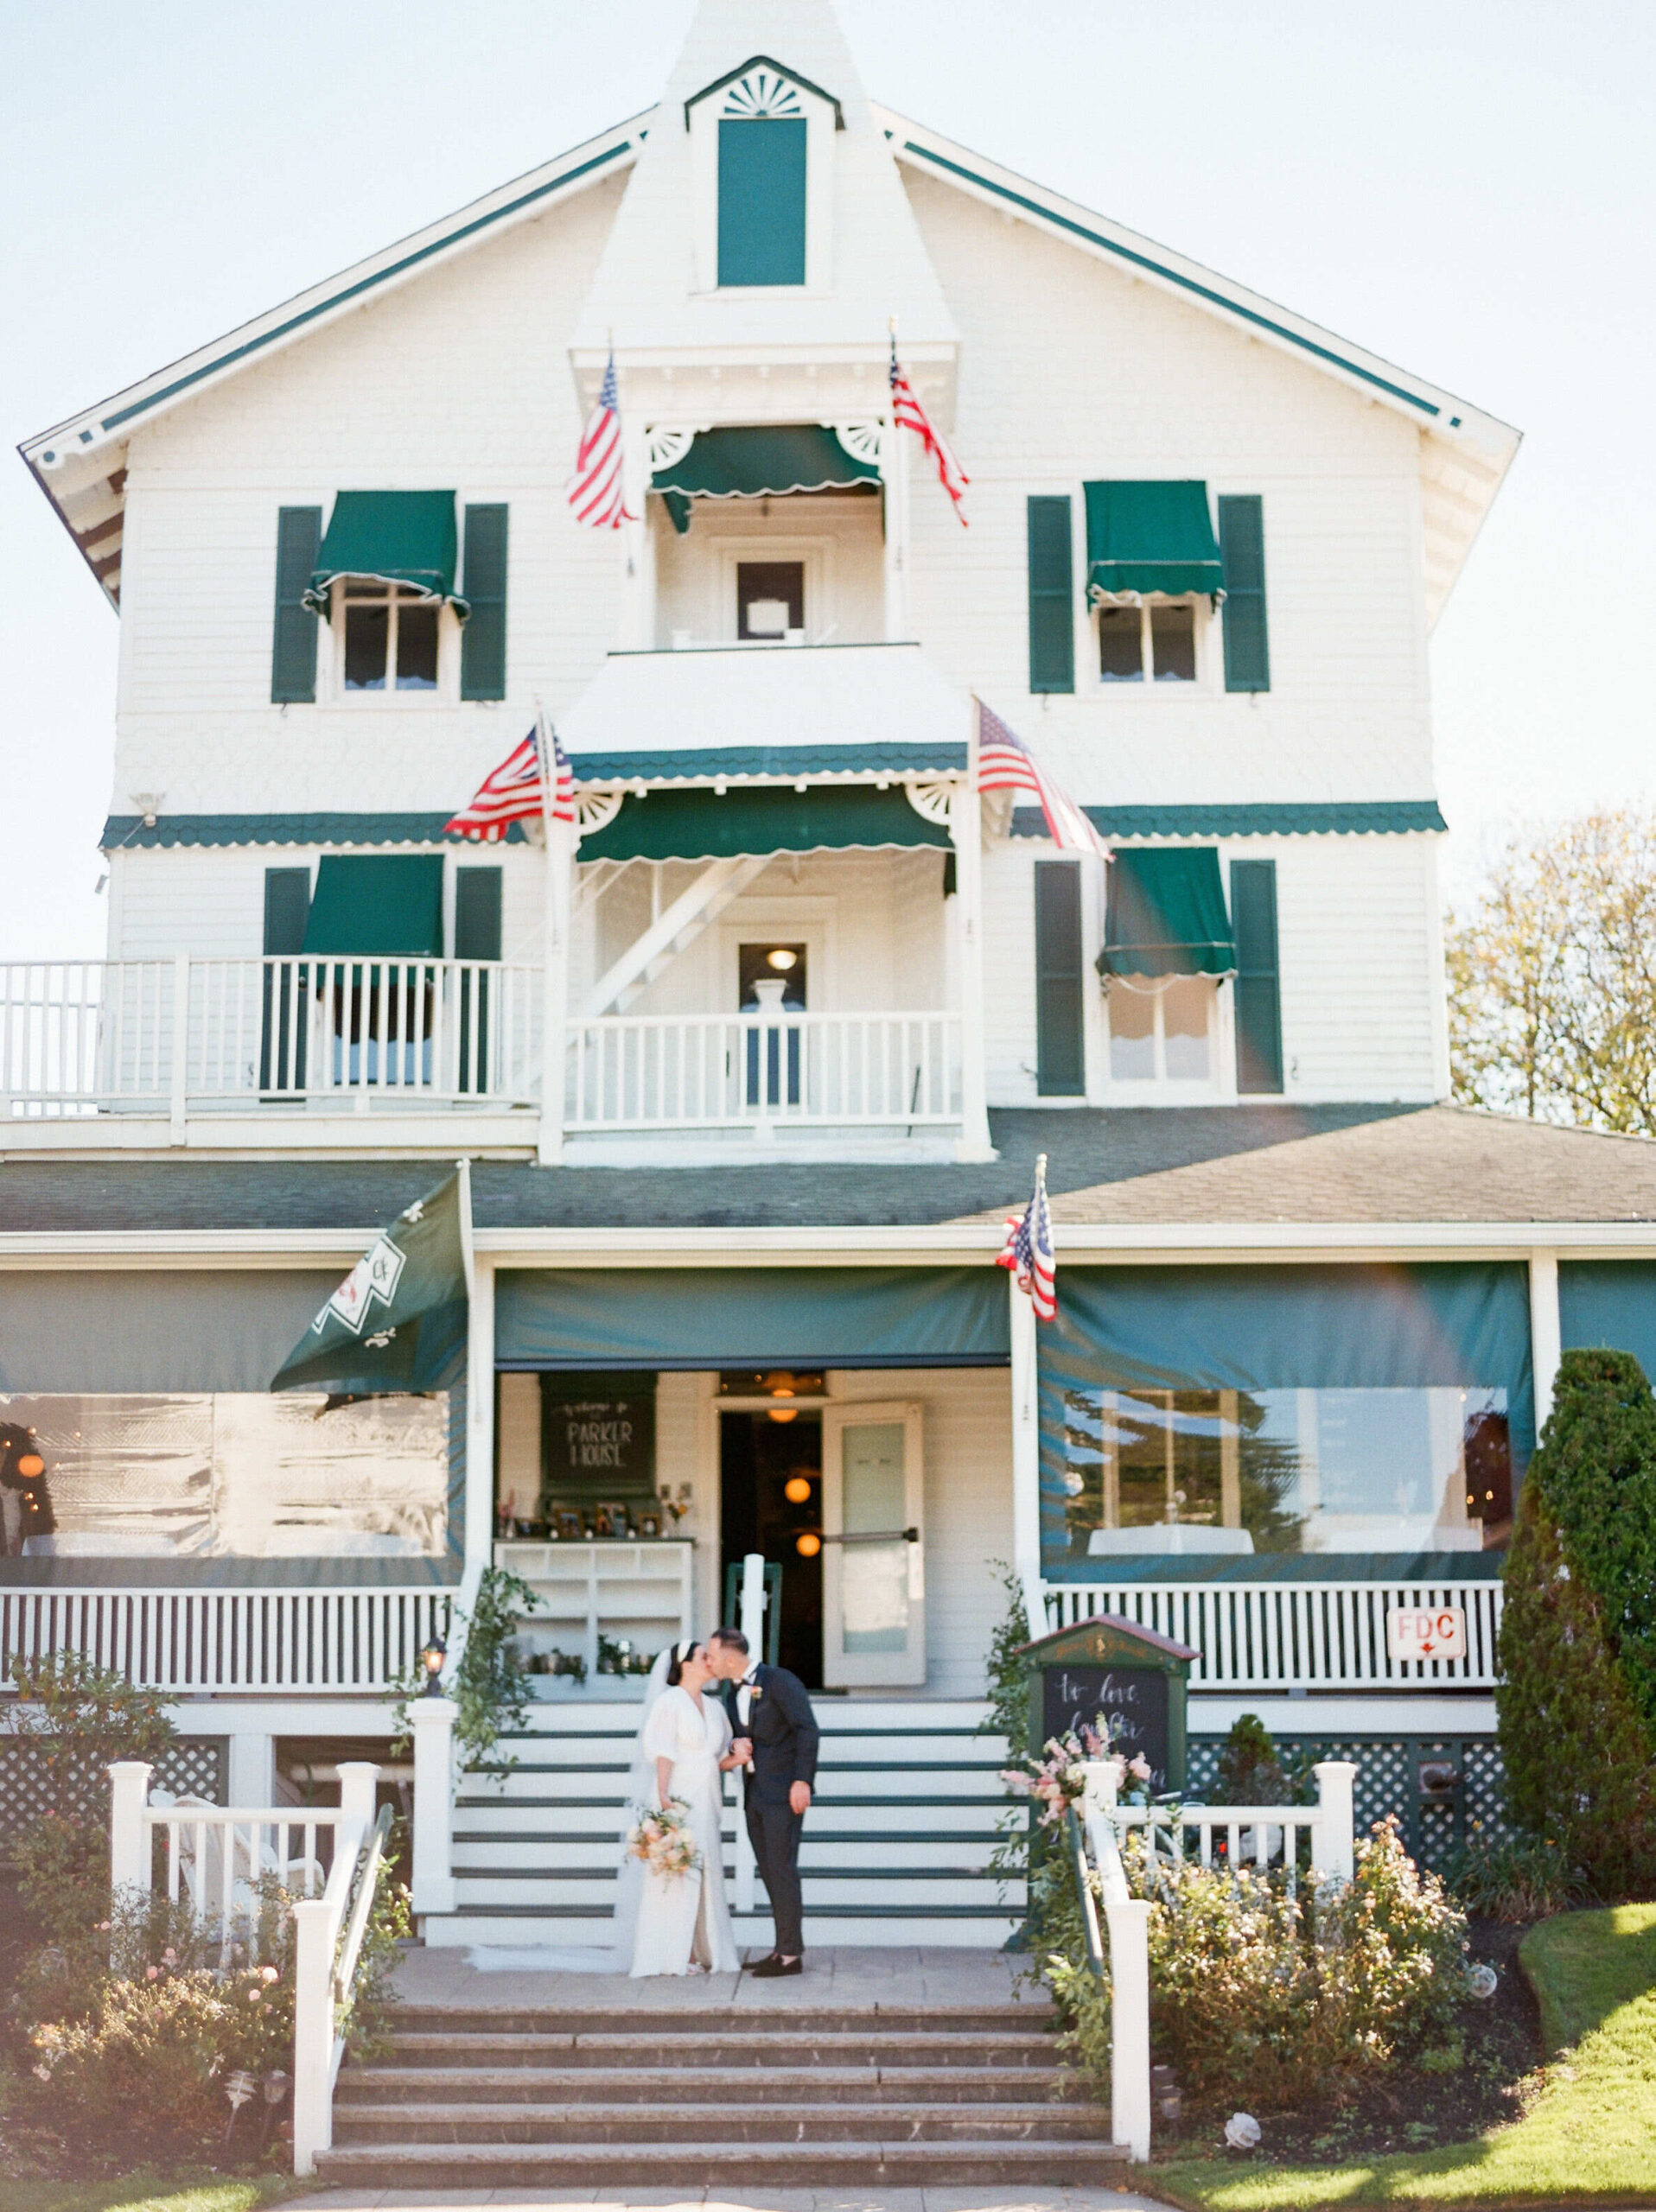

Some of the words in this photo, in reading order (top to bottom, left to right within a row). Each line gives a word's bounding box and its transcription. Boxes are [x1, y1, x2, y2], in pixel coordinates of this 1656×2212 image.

[566, 1421, 633, 1443] PARKER
[1398, 1614, 1454, 1639] FDC
[1054, 1673, 1088, 1702] to
